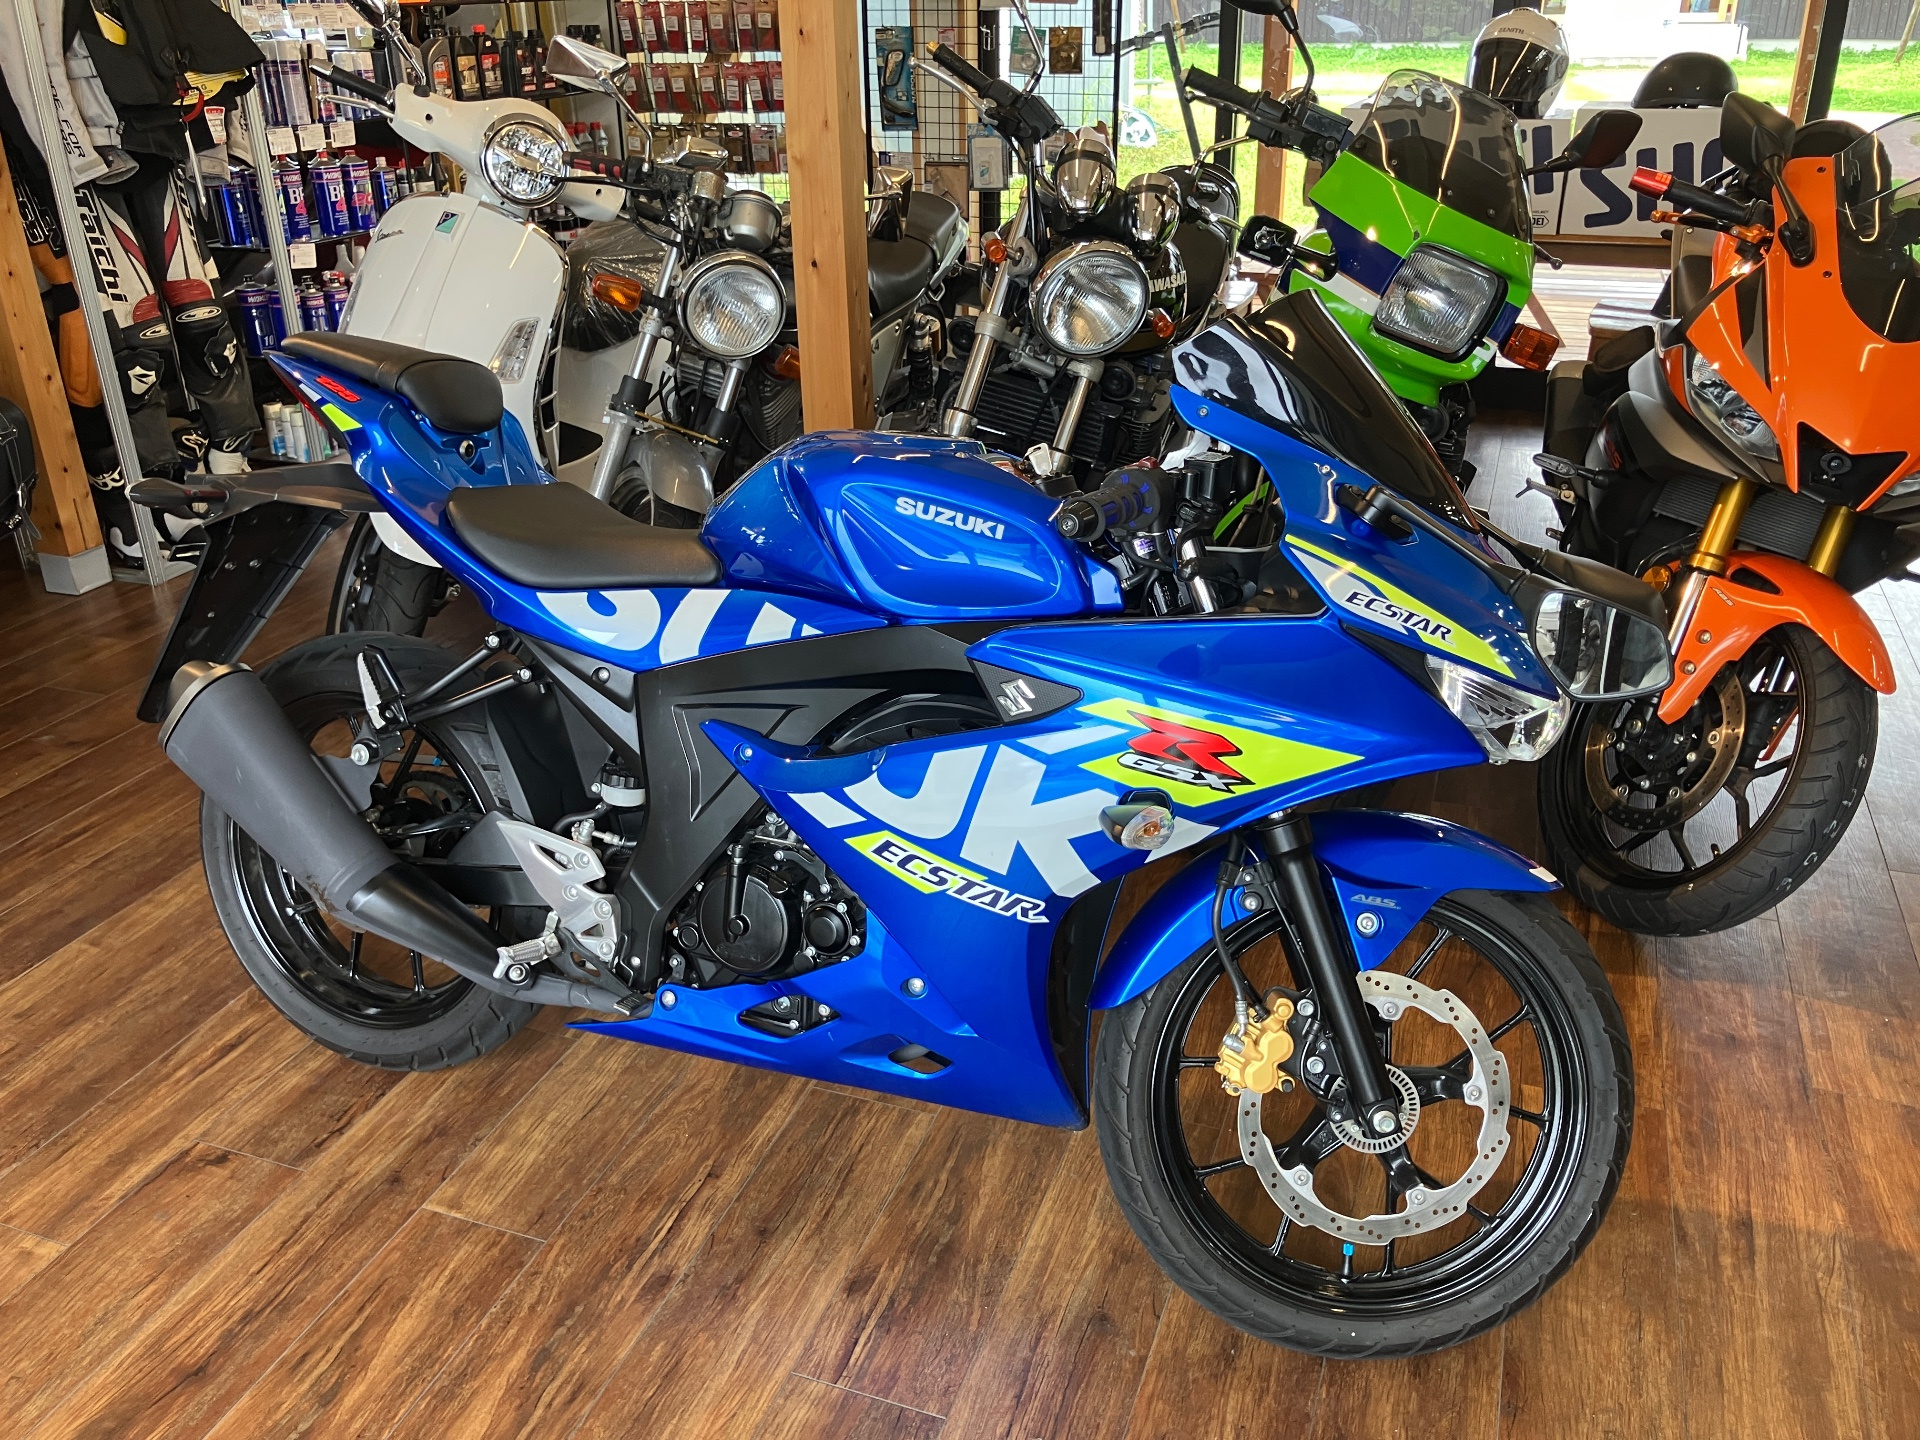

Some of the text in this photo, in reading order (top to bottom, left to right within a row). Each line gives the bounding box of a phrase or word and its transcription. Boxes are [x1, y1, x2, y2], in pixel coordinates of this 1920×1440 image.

[61, 119, 86, 158] FOR
[1148, 270, 1187, 293] AWASAKI
[895, 496, 1005, 540] SUZUKI
[1345, 590, 1456, 646] ECSTAR
[1117, 752, 1241, 793] GSX
[868, 838, 1050, 923] ECSTAR
[1350, 893, 1399, 909] ABS
